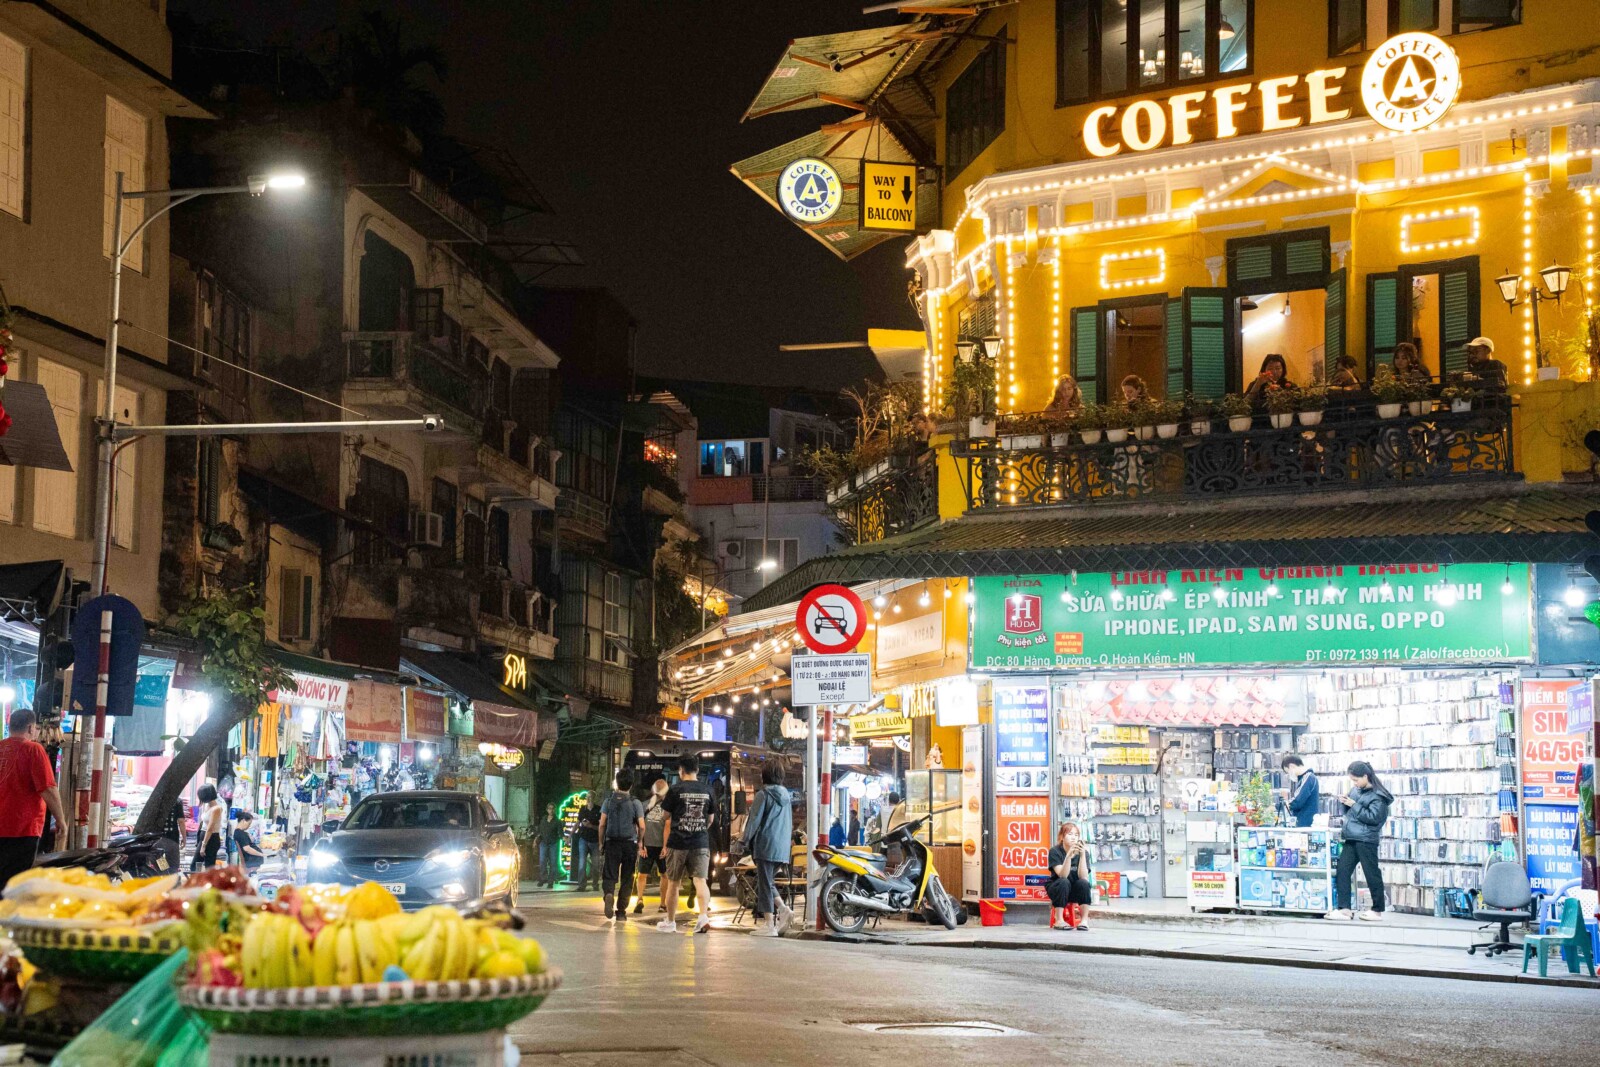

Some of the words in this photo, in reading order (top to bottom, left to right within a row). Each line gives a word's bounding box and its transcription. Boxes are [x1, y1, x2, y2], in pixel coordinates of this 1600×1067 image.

[1376, 40, 1445, 68] COFFEE
[1082, 66, 1352, 157] COFFEE
[1375, 93, 1446, 123] COFFEE
[790, 163, 834, 183] COFFEE
[873, 175, 896, 186] WAY
[878, 189, 891, 200] TO
[790, 200, 833, 217] COFFEE
[867, 206, 913, 222] BALCONY
[1067, 590, 1106, 612] SỬA
[1113, 589, 1166, 612] CHỮA
[1184, 588, 1211, 609] ÉP
[1217, 587, 1268, 608] KÍNH
[1292, 588, 1348, 606] THAY
[1424, 580, 1482, 600] HNH
[1104, 618, 1185, 637] IPHONE,
[1188, 617, 1243, 636] IPAD,
[1247, 615, 1297, 633] SAM
[1305, 612, 1375, 632] SUNG,
[1381, 610, 1445, 629] OPPO
[997, 634, 1012, 648] Phụ
[1014, 637, 1032, 648] kiện
[1035, 633, 1048, 644] tốt
[986, 655, 1006, 666] ĐC:
[1007, 655, 1019, 666] 80
[1024, 655, 1050, 668] Hàng
[1055, 654, 1091, 667] Đường
[1143, 651, 1171, 664] Kiếm
[1179, 652, 1195, 663] HN
[1329, 649, 1356, 661] 0972
[1360, 648, 1378, 660] 139
[1382, 648, 1400, 660] 114
[504, 653, 527, 690] SPA
[795, 661, 801, 669] XE
[328, 684, 342, 703] VY
[818, 682, 838, 692] NGOẠI
[838, 680, 846, 692] LỆ
[820, 692, 845, 701] Except
[853, 720, 866, 729] WAY
[1525, 739, 1585, 764] 4G/5G
[1001, 800, 1024, 816] ĐIỂM
[1027, 802, 1047, 816] BÁN
[1008, 822, 1041, 843] SIM
[1001, 847, 1049, 869] 4G/5G
[1544, 860, 1556, 873] LẤY
[1557, 862, 1573, 873] NGAY
[383, 885, 402, 893] 5.42
[1530, 877, 1552, 889] REPAIR
